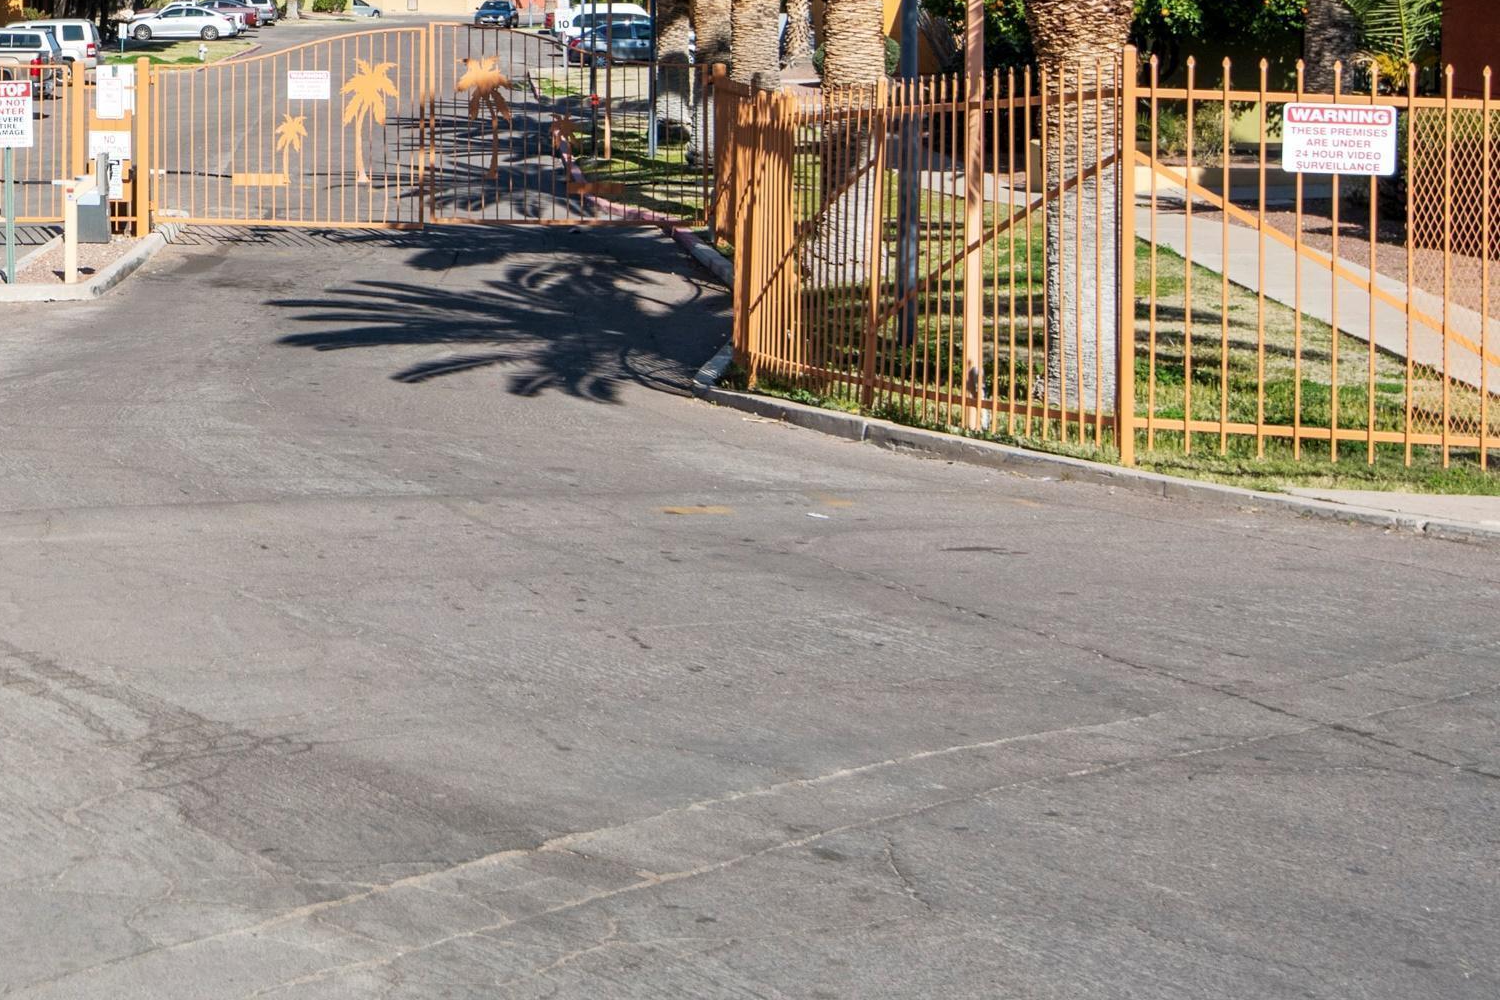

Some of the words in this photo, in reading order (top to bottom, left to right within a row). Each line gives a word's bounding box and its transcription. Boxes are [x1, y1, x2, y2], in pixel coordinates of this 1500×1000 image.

[558, 20, 570, 29] 10
[1290, 107, 1389, 124] WARNING
[1291, 126, 1327, 136] THESE
[1330, 127, 1388, 138] PREMISES
[104, 135, 116, 144] NO
[1306, 138, 1328, 147] ARE
[1332, 139, 1371, 148] UNDER
[1295, 149, 1308, 158] 24
[1312, 150, 1344, 159] HOUR
[1347, 151, 1382, 160] VIDEO
[1296, 160, 1380, 172] SURVEILLANCE
